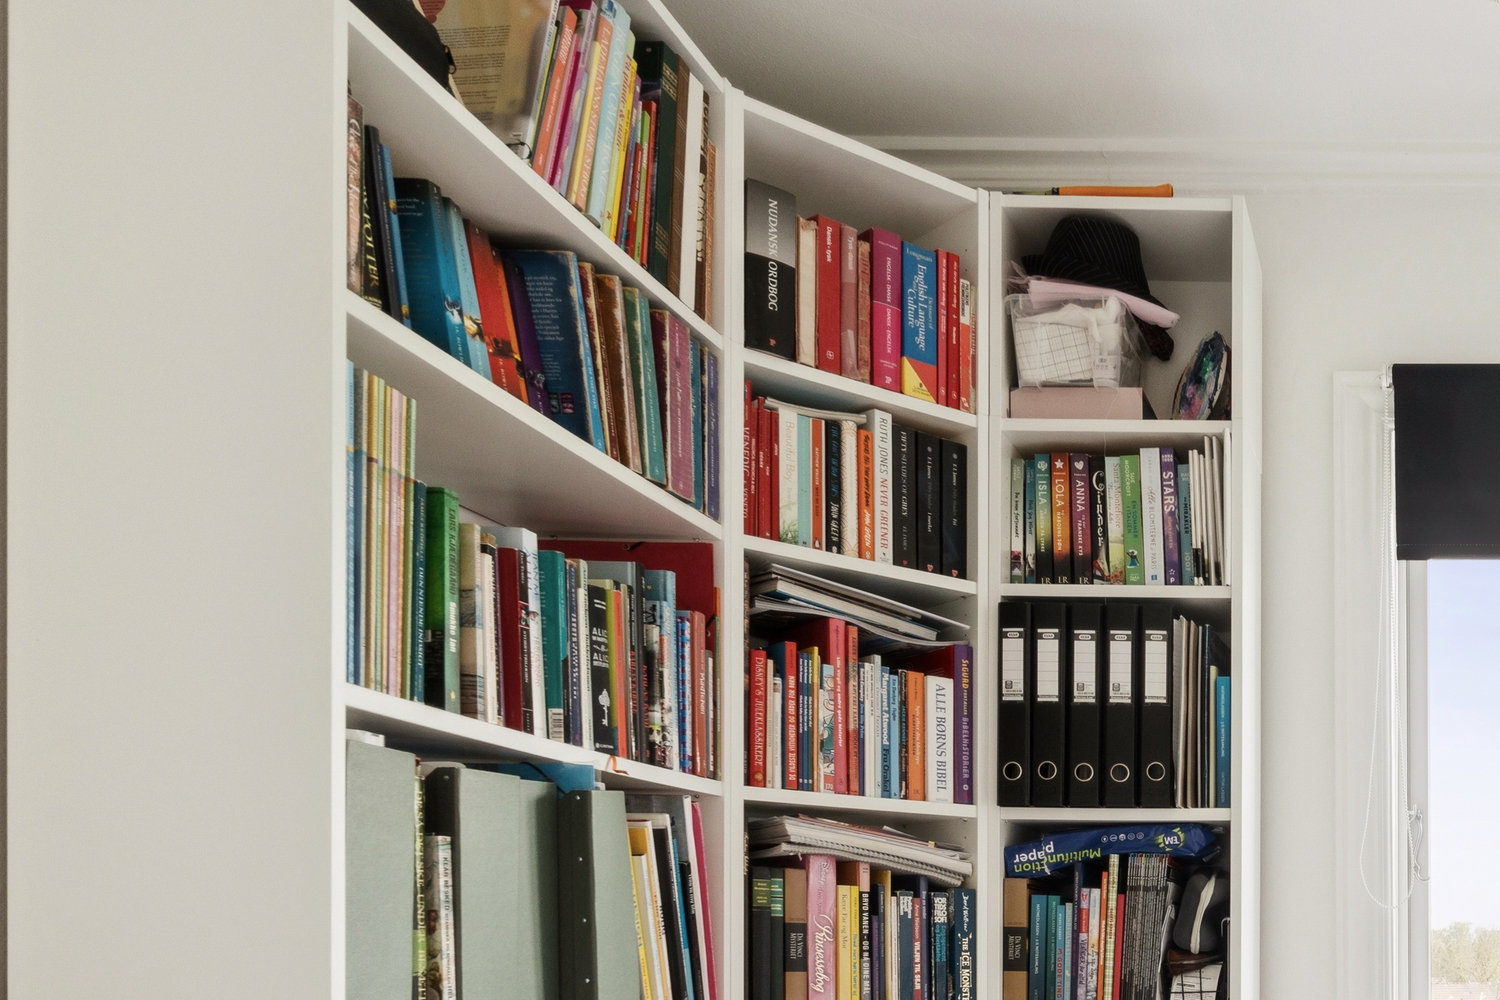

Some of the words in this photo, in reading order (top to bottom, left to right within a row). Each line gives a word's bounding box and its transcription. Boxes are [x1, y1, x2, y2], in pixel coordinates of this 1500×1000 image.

[767, 198, 778, 257] NUDANSK
[825, 226, 834, 246] Dansk
[767, 261, 779, 311] ORDBOG
[913, 263, 928, 301] English
[907, 288, 917, 329] Culture
[913, 302, 928, 352] Language
[785, 421, 795, 461] Beautiful
[879, 417, 888, 443] RUTH
[900, 431, 908, 452] FIFTY
[784, 464, 795, 482] Boy
[878, 445, 888, 474] JONES
[1113, 463, 1121, 483] Santa
[880, 477, 888, 506] NEVER
[900, 496, 908, 517] GREY
[1038, 480, 1047, 505] ISLA
[1055, 478, 1064, 507] LOLA
[1075, 479, 1085, 512] ANNA
[1114, 485, 1122, 529] Montefiore
[1163, 471, 1175, 513] STARS
[880, 510, 888, 549] GREENER
[754, 657, 764, 696] DISNEY'S
[881, 673, 889, 711] Margaret
[935, 684, 945, 713] ALLE
[936, 717, 946, 757] BØRNS
[937, 760, 946, 793] BIBEL
[1013, 840, 1054, 864] paper
[811, 914, 834, 993] Prinsessebog
[863, 940, 869, 950] OG
[863, 952, 870, 960] NÅ
[961, 952, 970, 967] ICE
